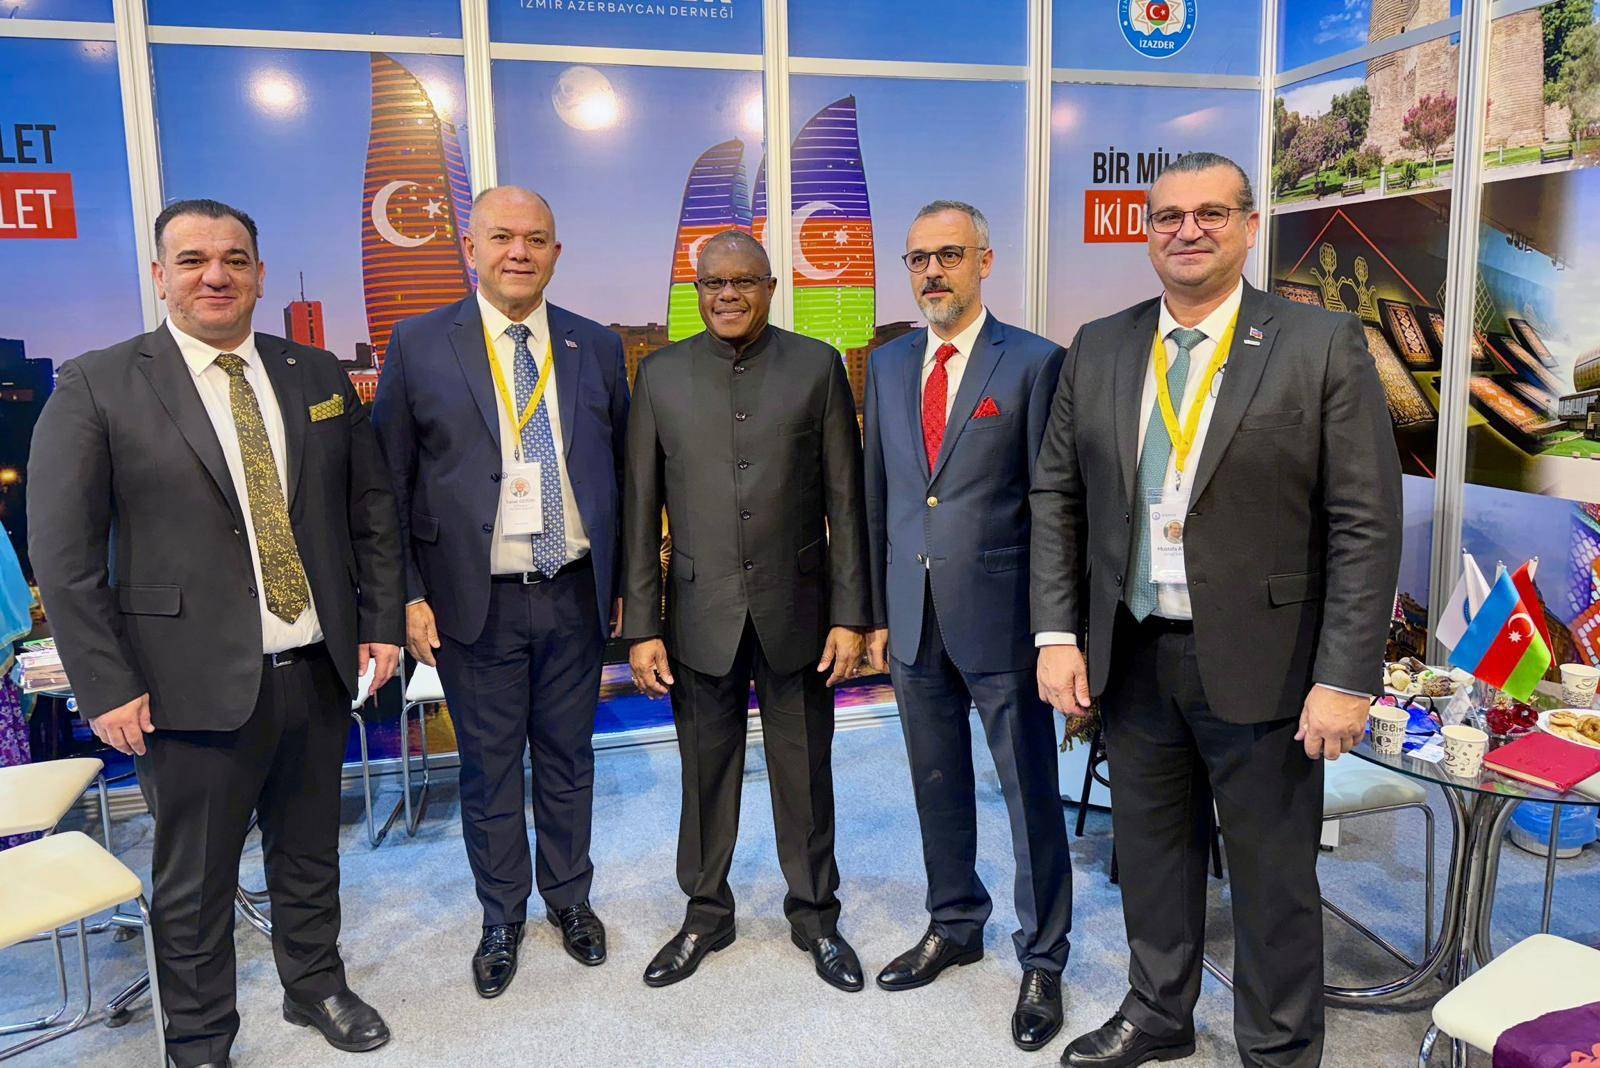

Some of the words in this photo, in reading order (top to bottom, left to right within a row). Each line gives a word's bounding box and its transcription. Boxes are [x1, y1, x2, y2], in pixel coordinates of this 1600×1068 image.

[567, 1, 665, 15] AZERBAYCAN
[669, 6, 734, 19] DERNEĞİ
[1139, 38, 1175, 49] İZAZDER
[1093, 146, 1130, 184] BİR
[1093, 198, 1121, 236] İKİ
